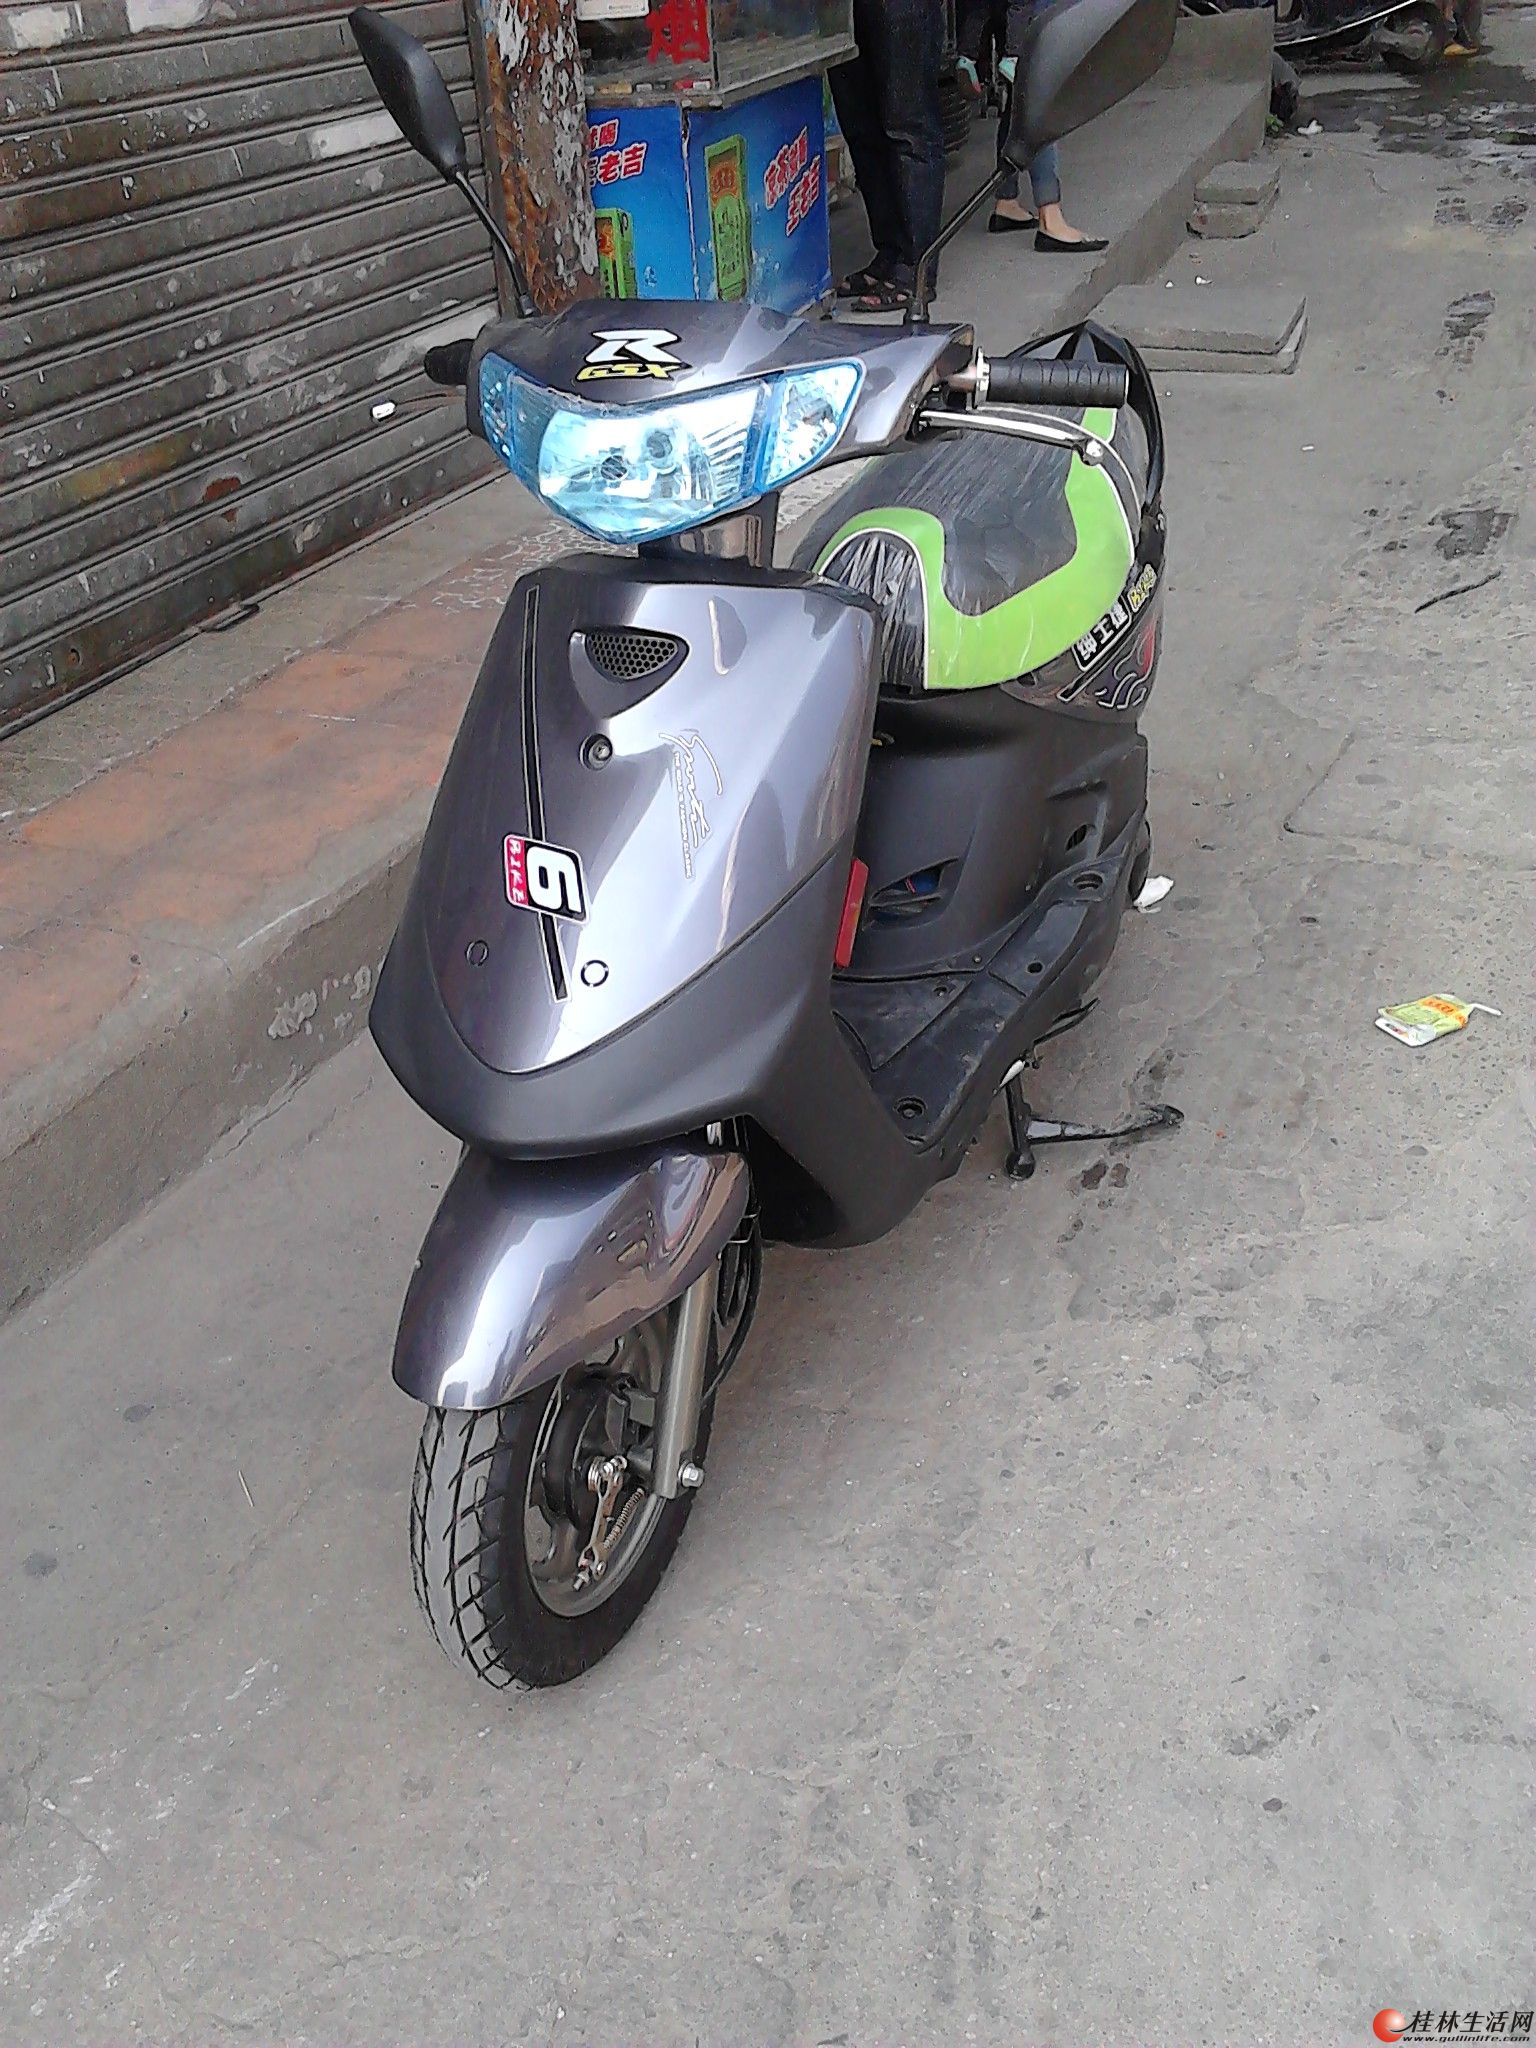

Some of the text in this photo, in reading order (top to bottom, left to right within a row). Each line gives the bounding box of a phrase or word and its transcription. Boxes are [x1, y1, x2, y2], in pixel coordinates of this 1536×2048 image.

[786, 154, 821, 237] 王老吉
[585, 328, 682, 364] R
[576, 363, 682, 381] GSX
